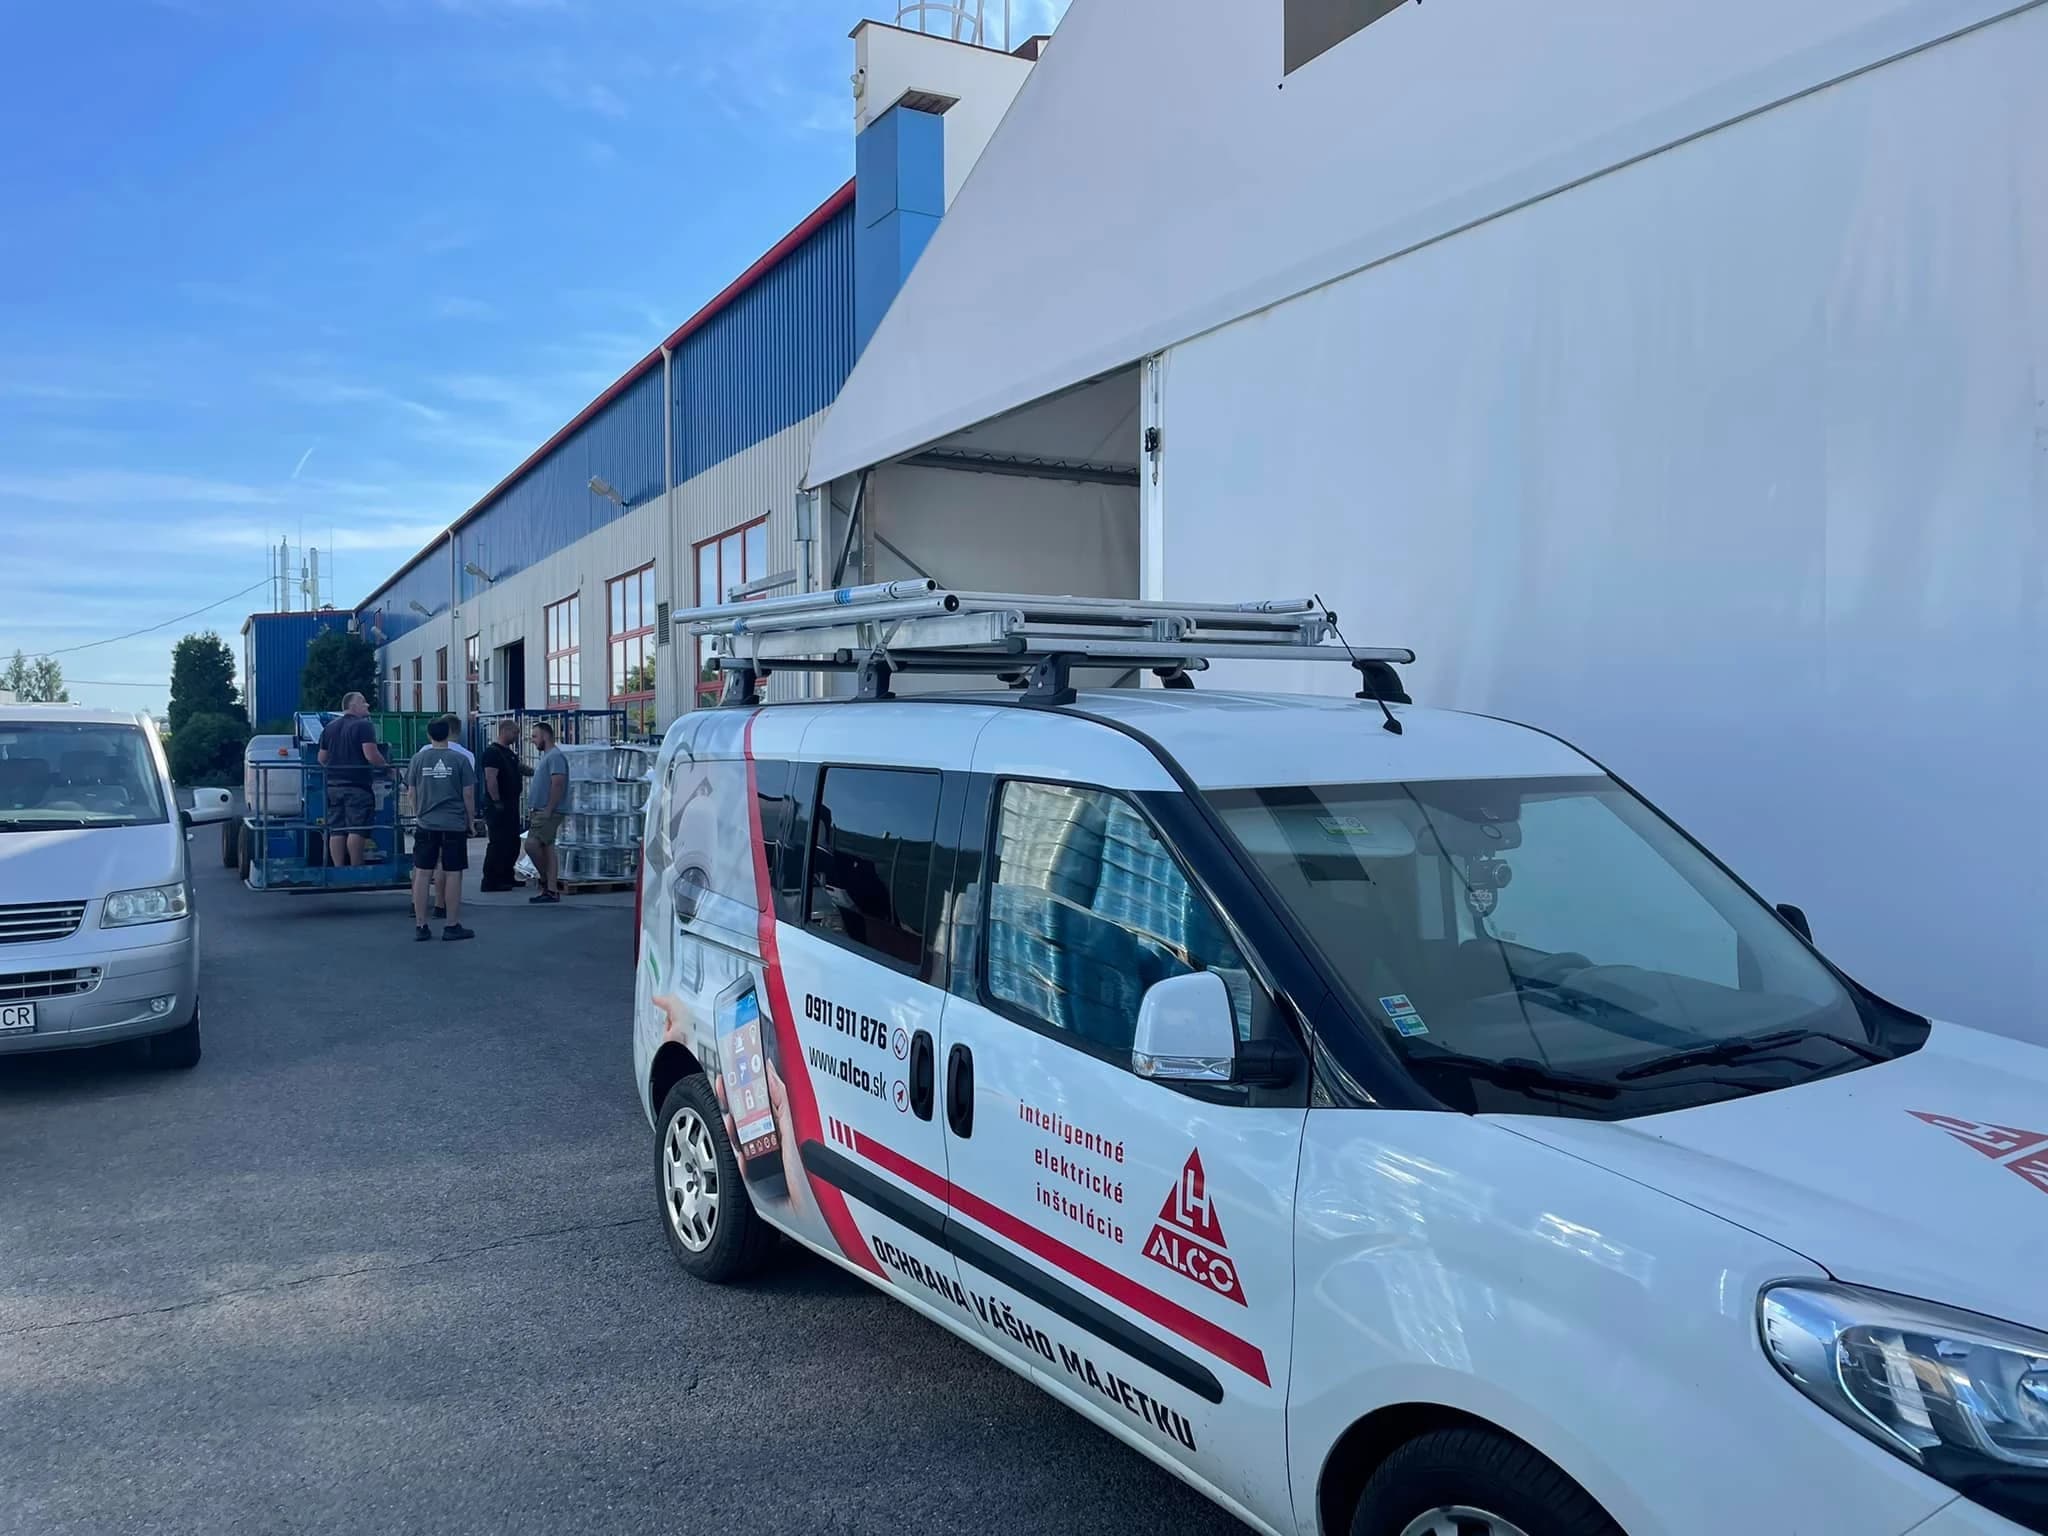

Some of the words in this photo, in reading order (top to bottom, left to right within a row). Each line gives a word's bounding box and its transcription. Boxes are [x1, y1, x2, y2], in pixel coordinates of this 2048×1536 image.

[805, 993, 833, 1027] 0911
[836, 1005, 857, 1038] 911
[860, 1015, 887, 1050] 876
[808, 1045, 887, 1101] www.alco.sk
[1019, 1098, 1125, 1164] inteligentné
[1034, 1148, 1124, 1204] elektrické
[1035, 1182, 1124, 1244] inštalácie
[1150, 1231, 1234, 1293] ALCO
[871, 1234, 971, 1313] OCHRANA
[969, 1290, 1057, 1364] VÁŠHO
[1057, 1343, 1197, 1452] MAJETKU
